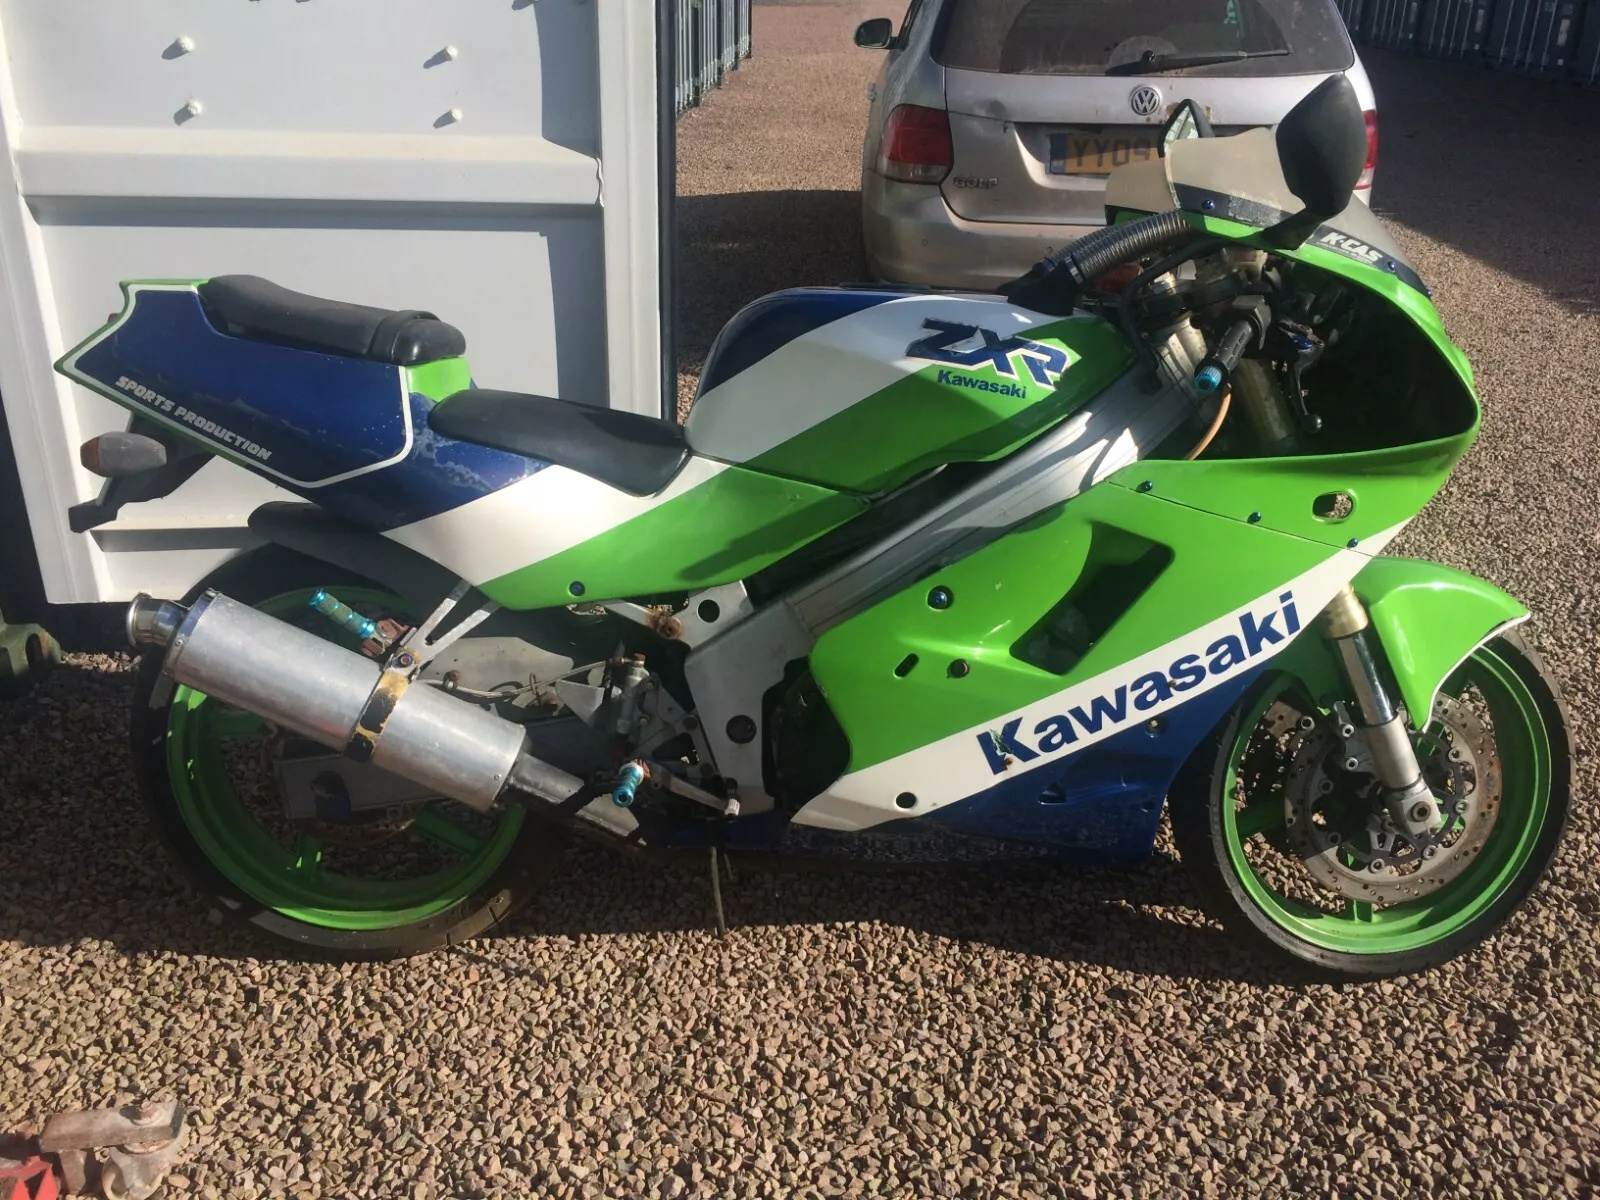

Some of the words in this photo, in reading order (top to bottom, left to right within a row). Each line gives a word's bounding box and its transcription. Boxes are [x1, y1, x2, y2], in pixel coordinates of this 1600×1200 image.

[953, 176, 999, 189] GOLF
[905, 317, 1070, 388] ZXR
[937, 369, 1026, 399] Kawasaki
[115, 375, 176, 412] SPORTS
[174, 406, 272, 461] PRODUCTION
[976, 590, 1301, 776] Kawasaki
